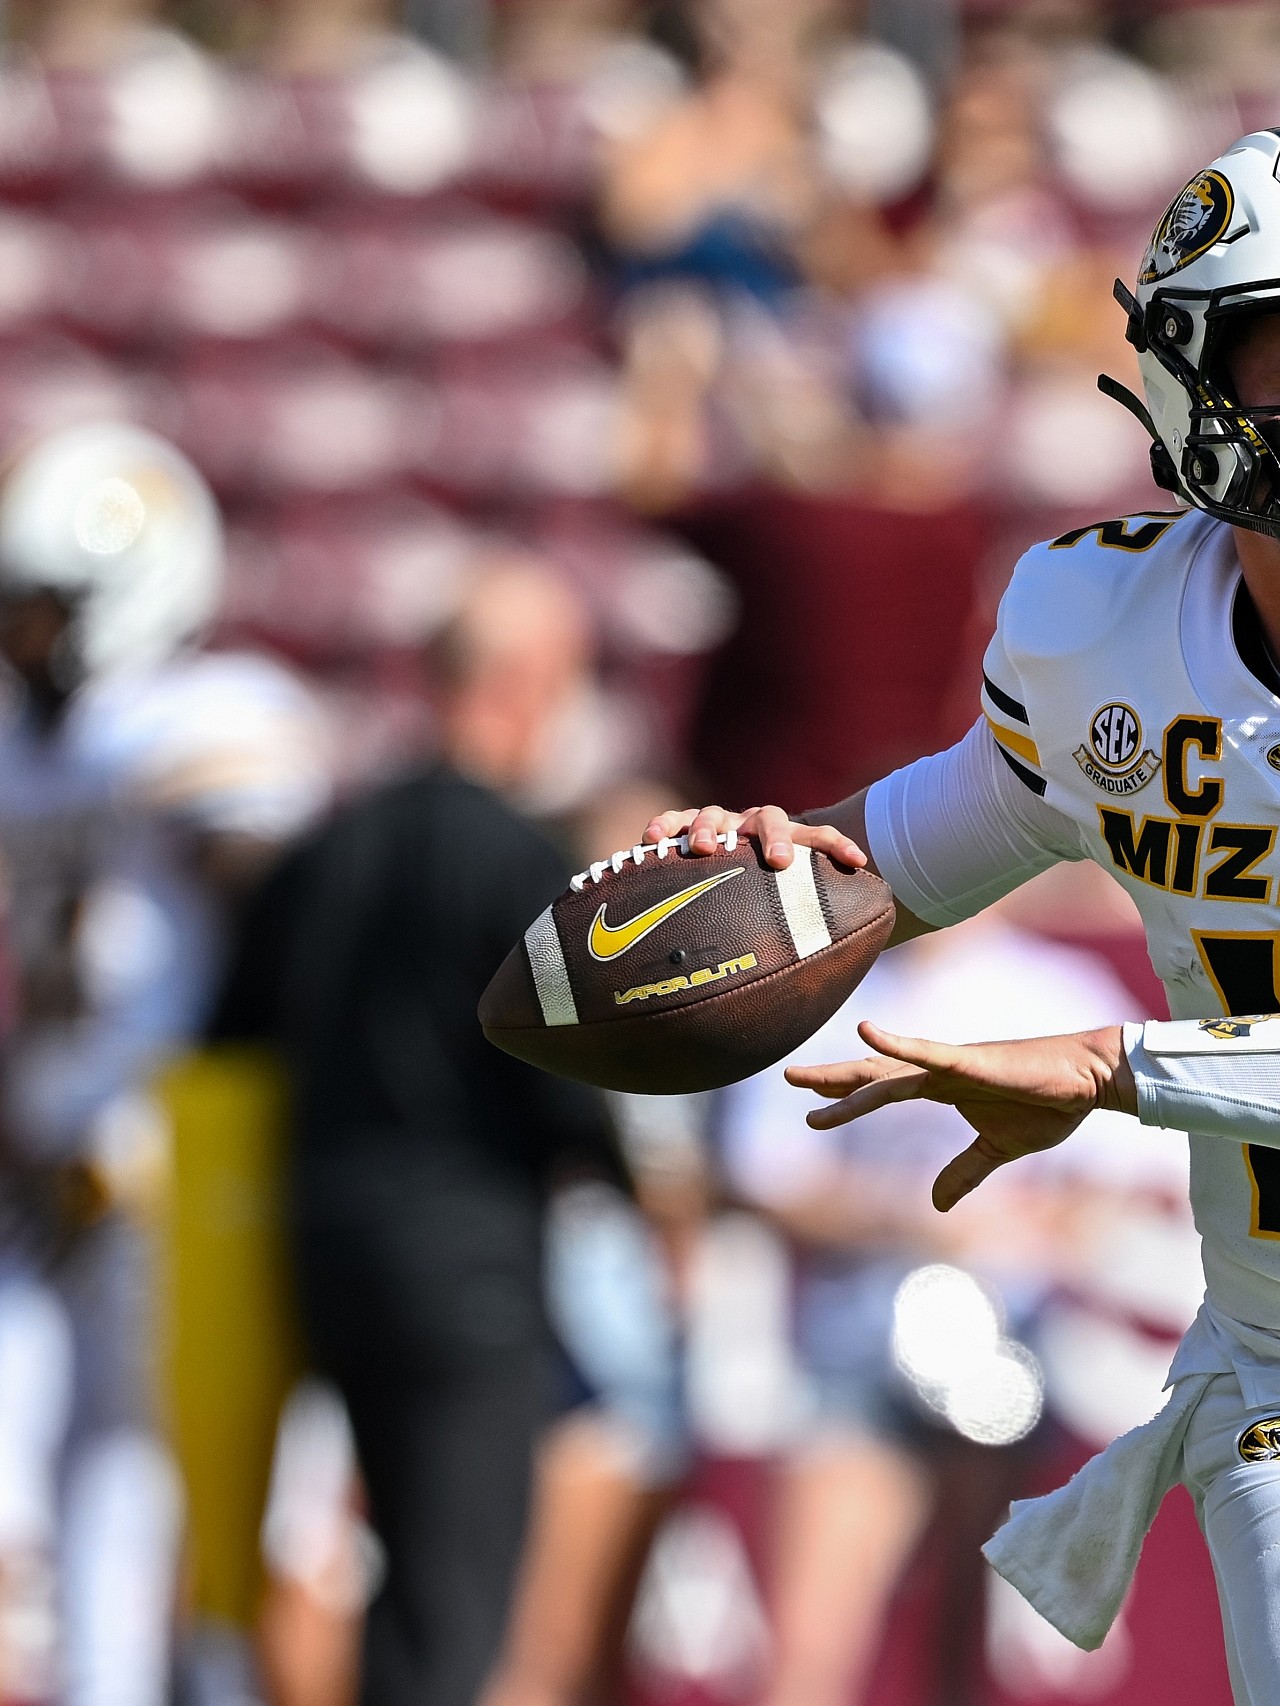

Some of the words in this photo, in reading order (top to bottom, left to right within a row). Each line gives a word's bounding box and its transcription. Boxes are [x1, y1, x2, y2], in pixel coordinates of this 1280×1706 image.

[1094, 707, 1136, 762] SEC
[1085, 763, 1148, 793] GRADUATE
[1161, 713, 1225, 819] C
[614, 975, 692, 1005] VAPOR
[690, 952, 758, 986] ELITE
